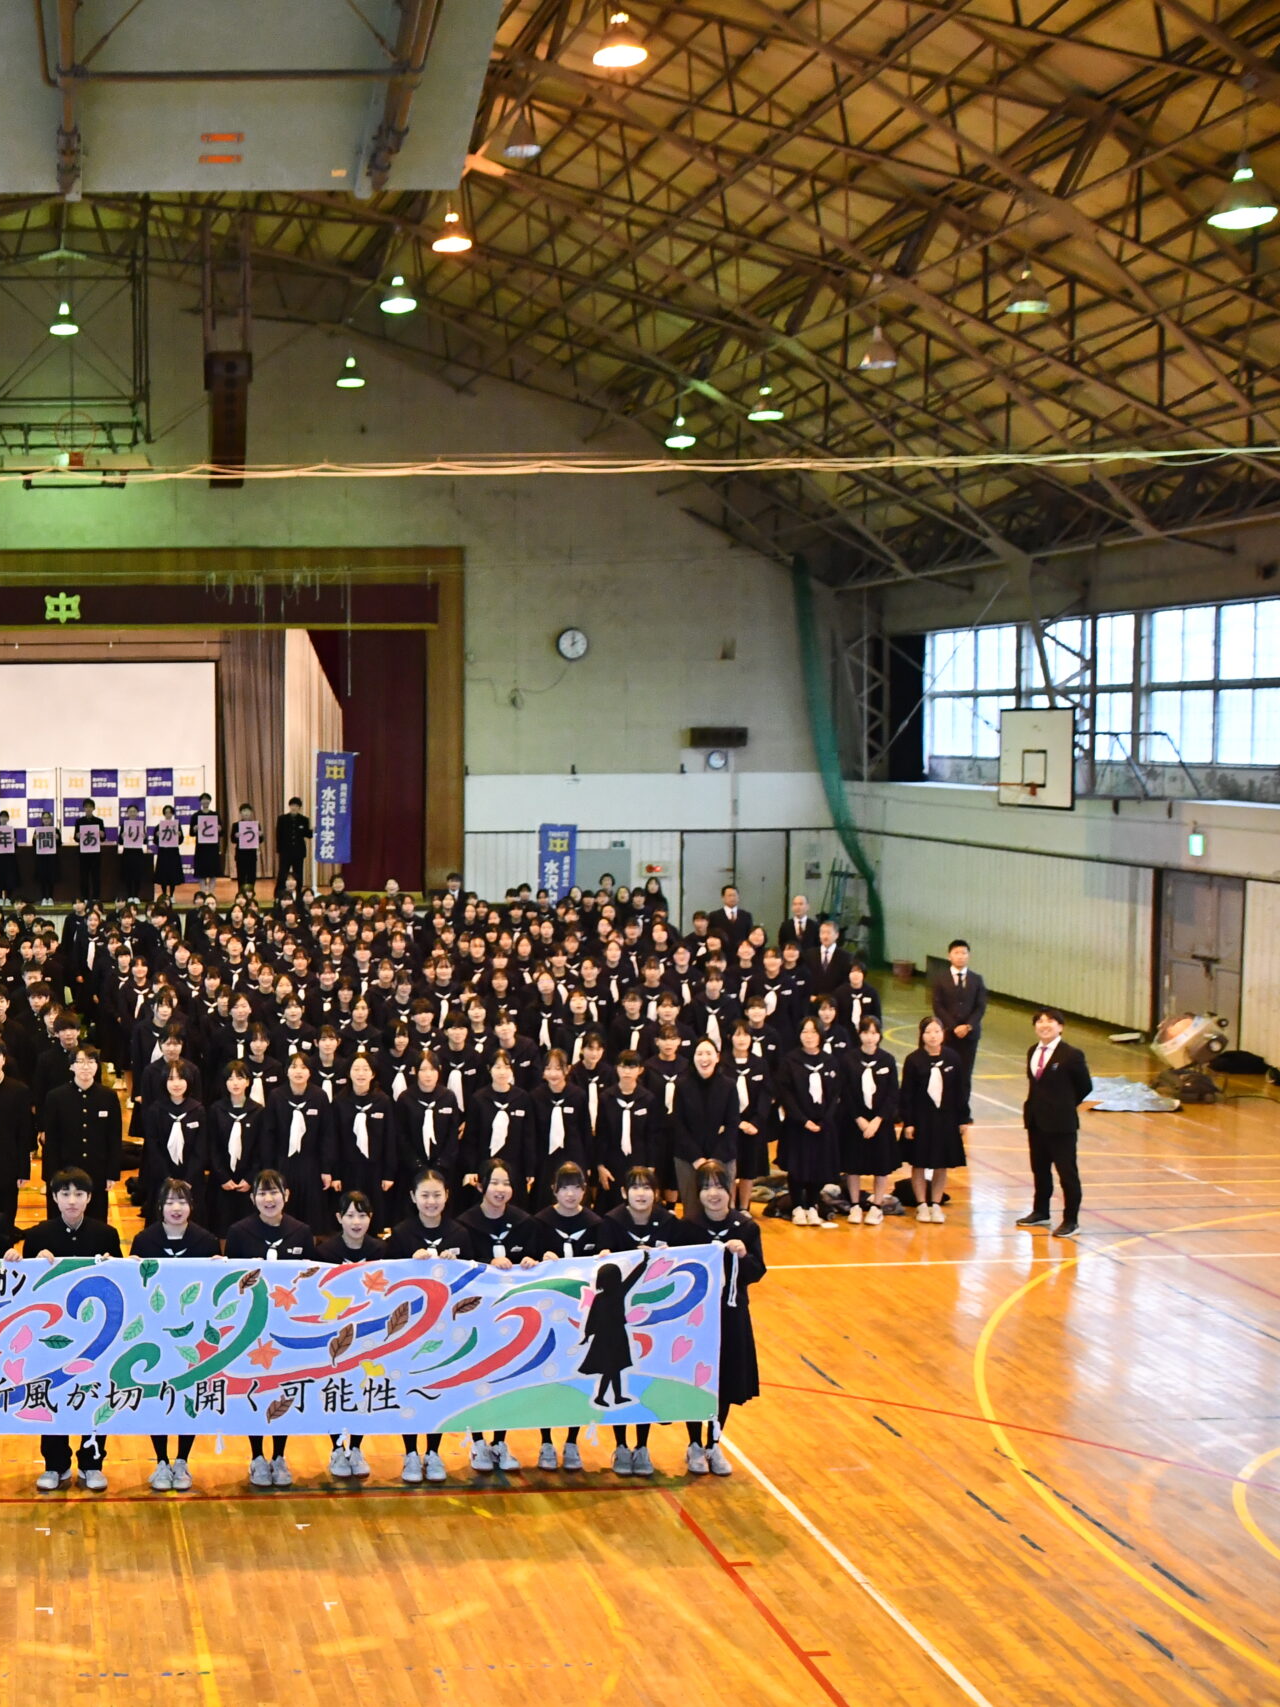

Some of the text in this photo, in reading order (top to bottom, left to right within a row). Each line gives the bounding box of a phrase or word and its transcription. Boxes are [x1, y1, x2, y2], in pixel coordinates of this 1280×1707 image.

[320, 786, 337, 860] 水沢中学校
